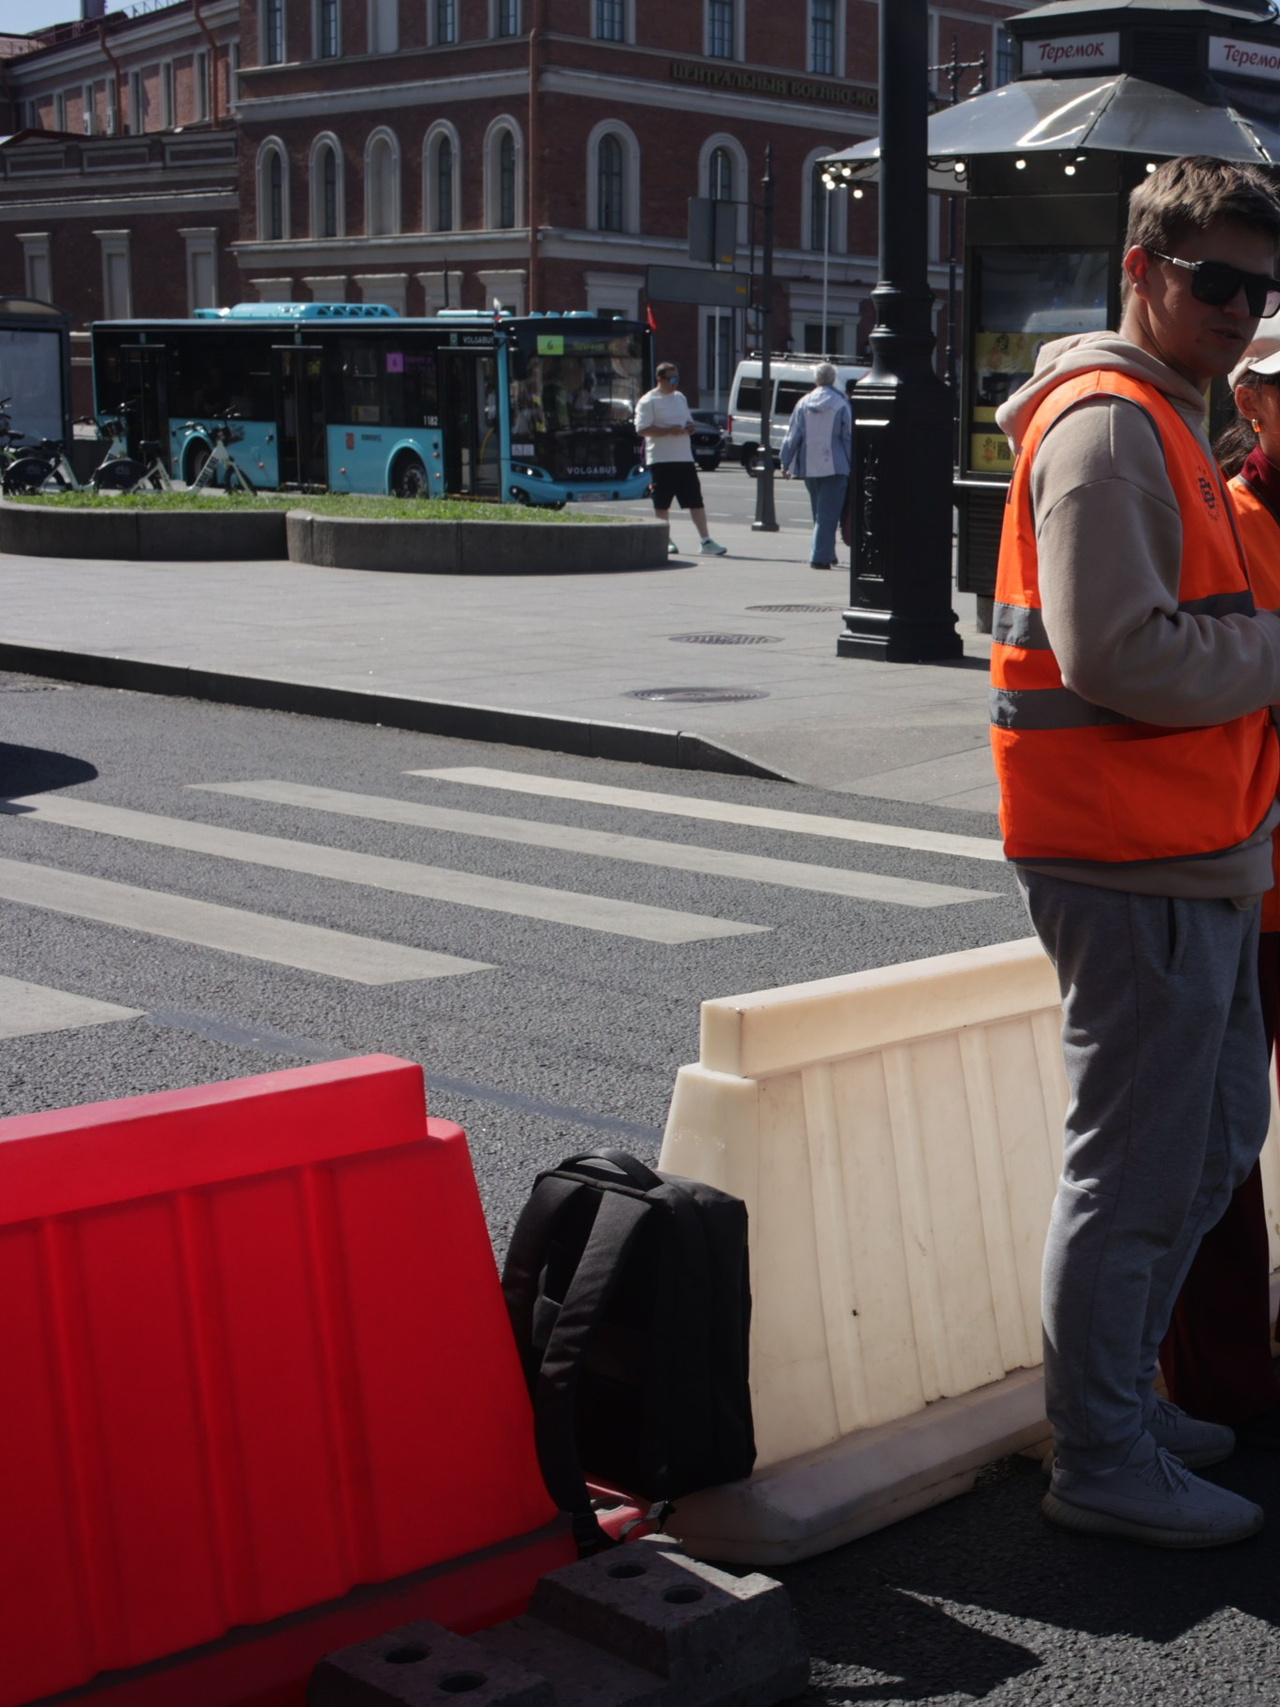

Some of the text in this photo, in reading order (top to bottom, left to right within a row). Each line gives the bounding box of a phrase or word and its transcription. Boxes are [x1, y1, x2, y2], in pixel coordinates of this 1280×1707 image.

[1038, 42, 1105, 62] Теремок
[673, 63, 789, 94] ЦЕНТРАЛЬНЫЙ
[567, 466, 618, 475] VOLGABUS
